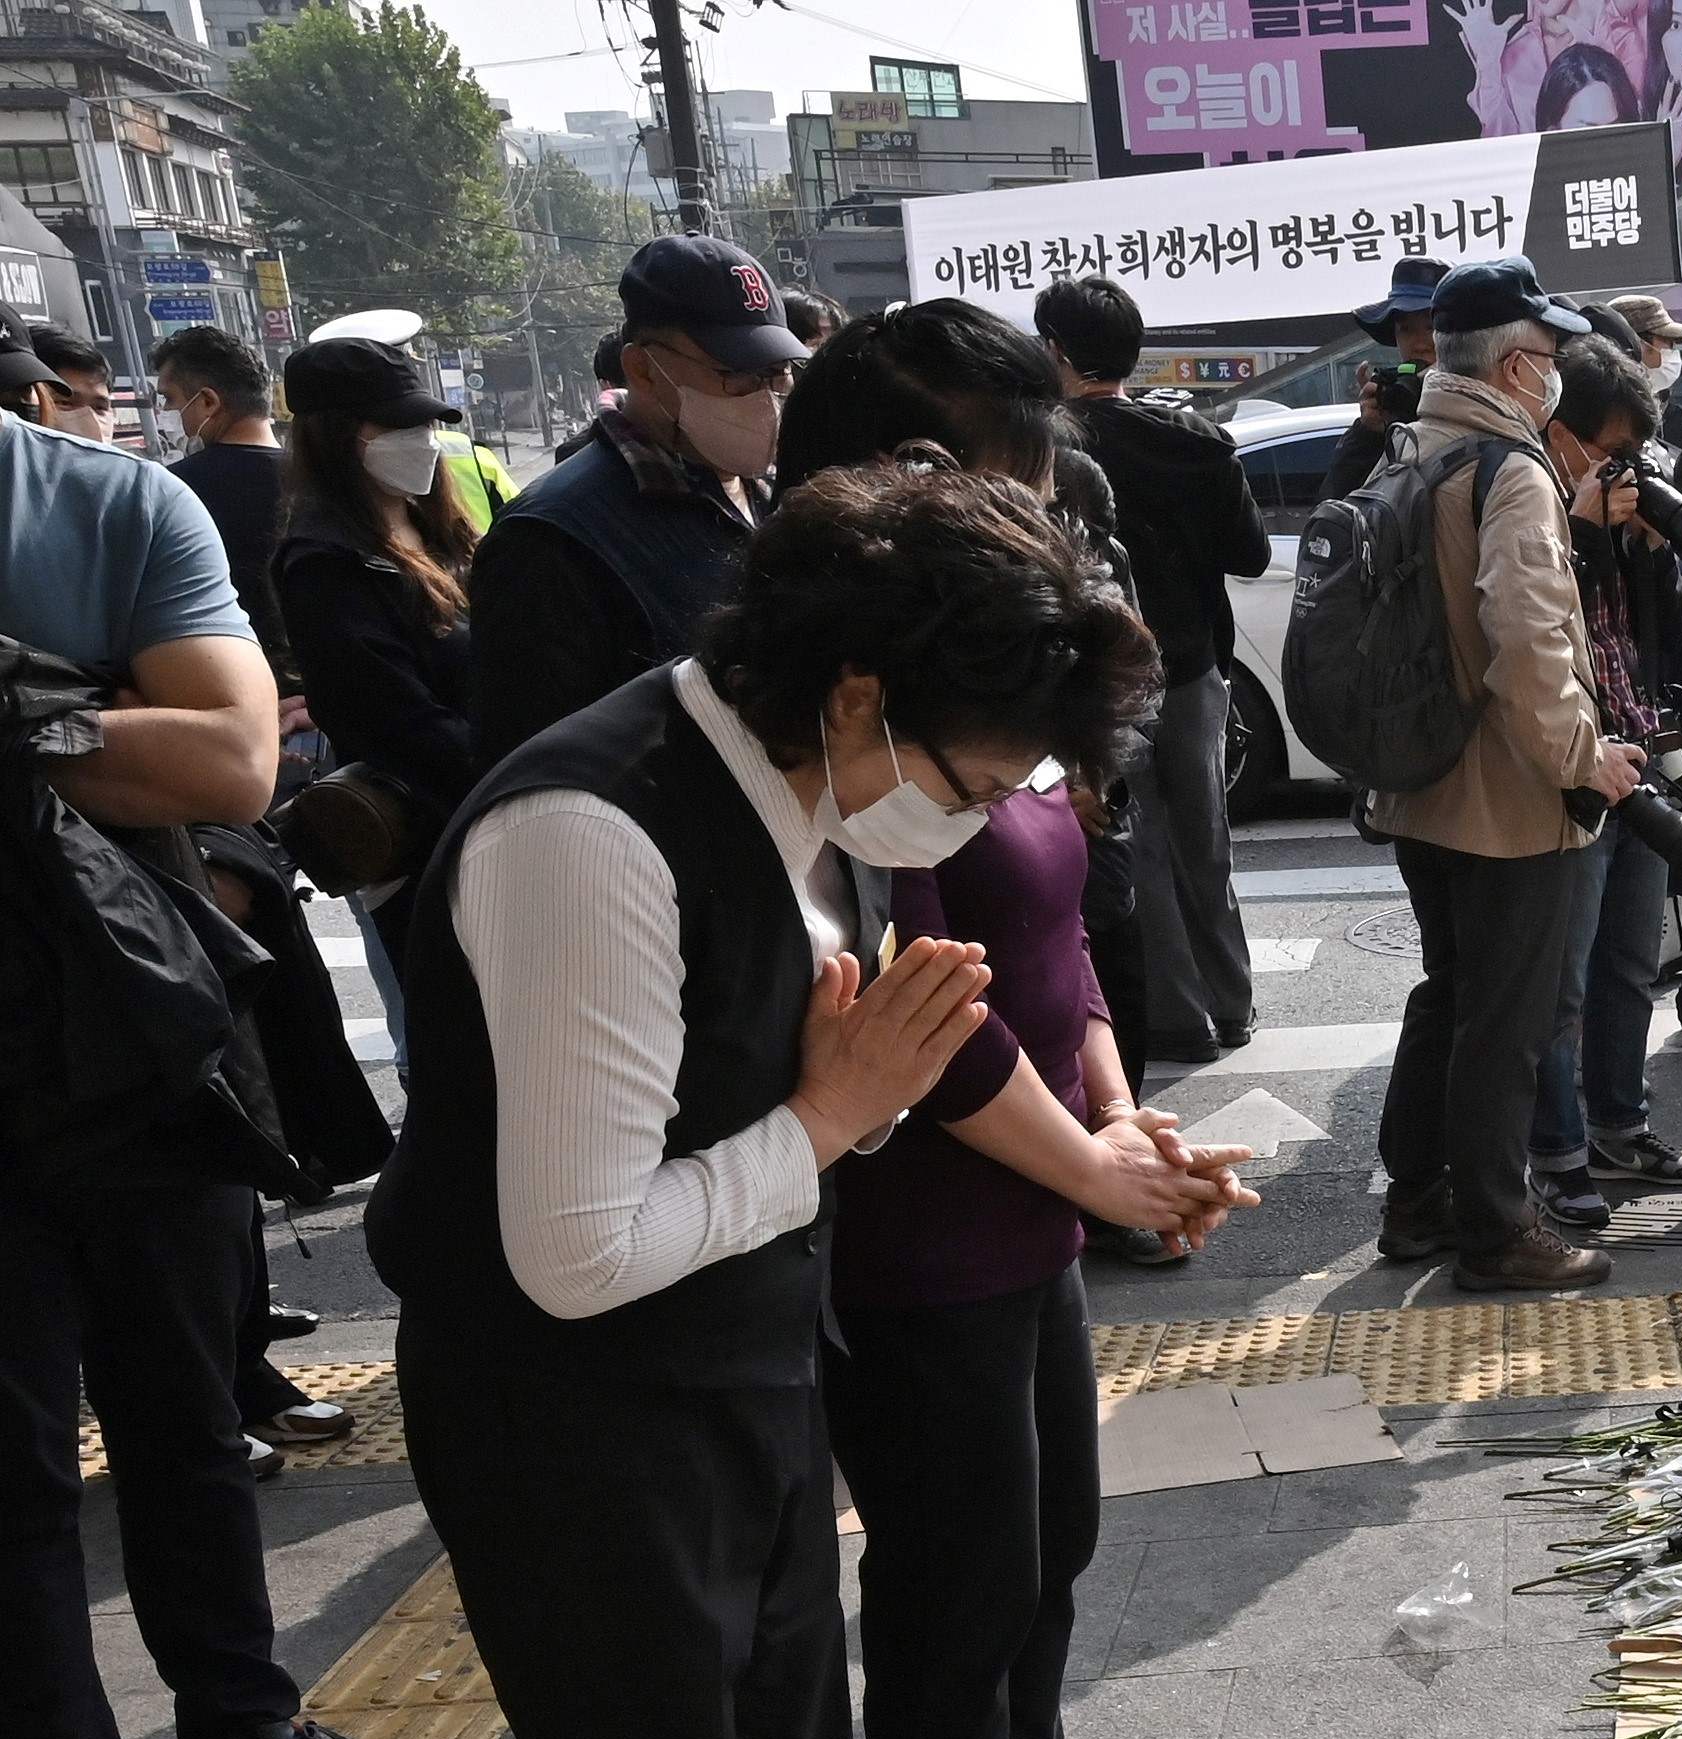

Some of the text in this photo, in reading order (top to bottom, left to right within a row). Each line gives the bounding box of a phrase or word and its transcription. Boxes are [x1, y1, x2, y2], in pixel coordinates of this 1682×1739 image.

[1126, 7, 1157, 44] 저
[840, 100, 899, 122] 노래방
[1144, 60, 1302, 131] 오늘이
[1564, 175, 1638, 214] 더불어
[935, 197, 1512, 294] 이태원 참사 희생자의 명복을 빕니다
[1566, 210, 1641, 250] 민주당
[731, 264, 771, 311] B
[1180, 363, 1190, 379] $
[1200, 363, 1210, 378] ¥
